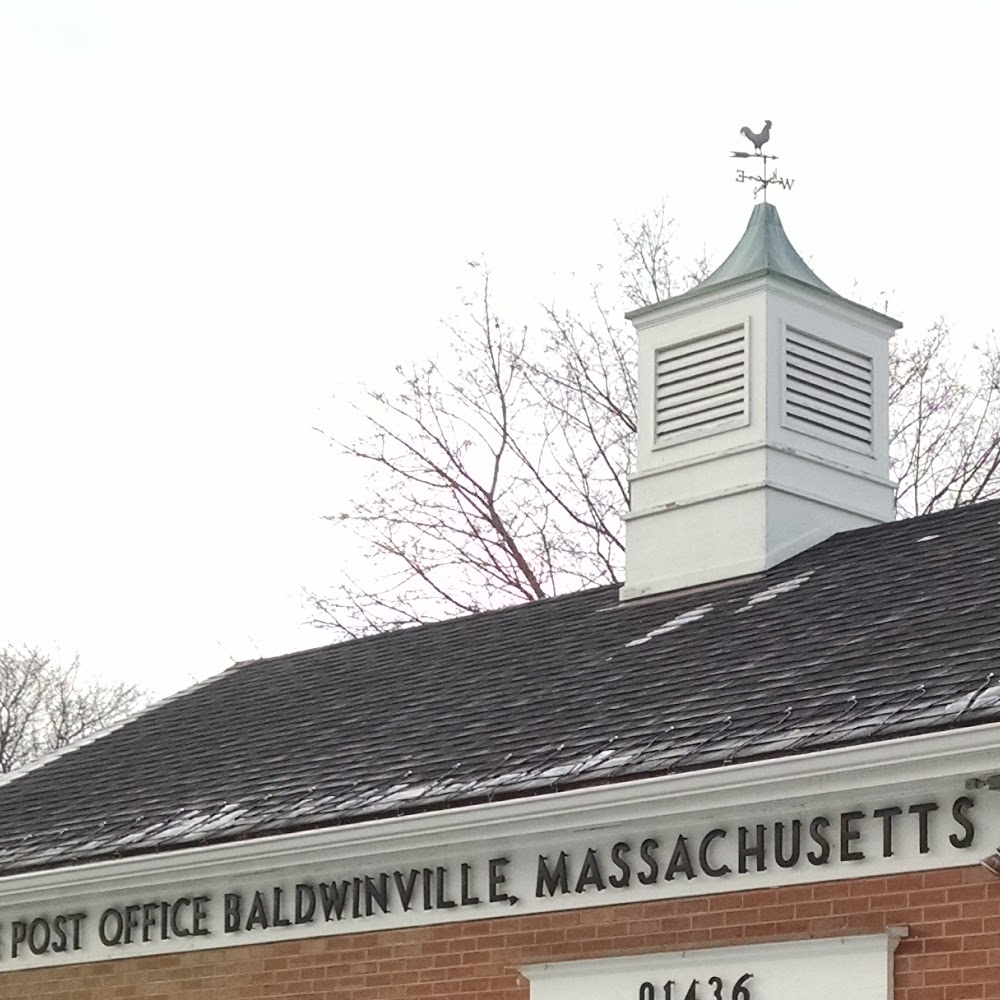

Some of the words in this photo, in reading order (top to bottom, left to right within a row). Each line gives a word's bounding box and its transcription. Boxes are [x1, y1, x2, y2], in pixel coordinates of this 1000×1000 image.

[11, 912, 87, 958] POST
[98, 896, 211, 947] OFFICE
[224, 857, 519, 934] BALDWINVILLE,
[535, 796, 975, 898] MASSACHUSETTS
